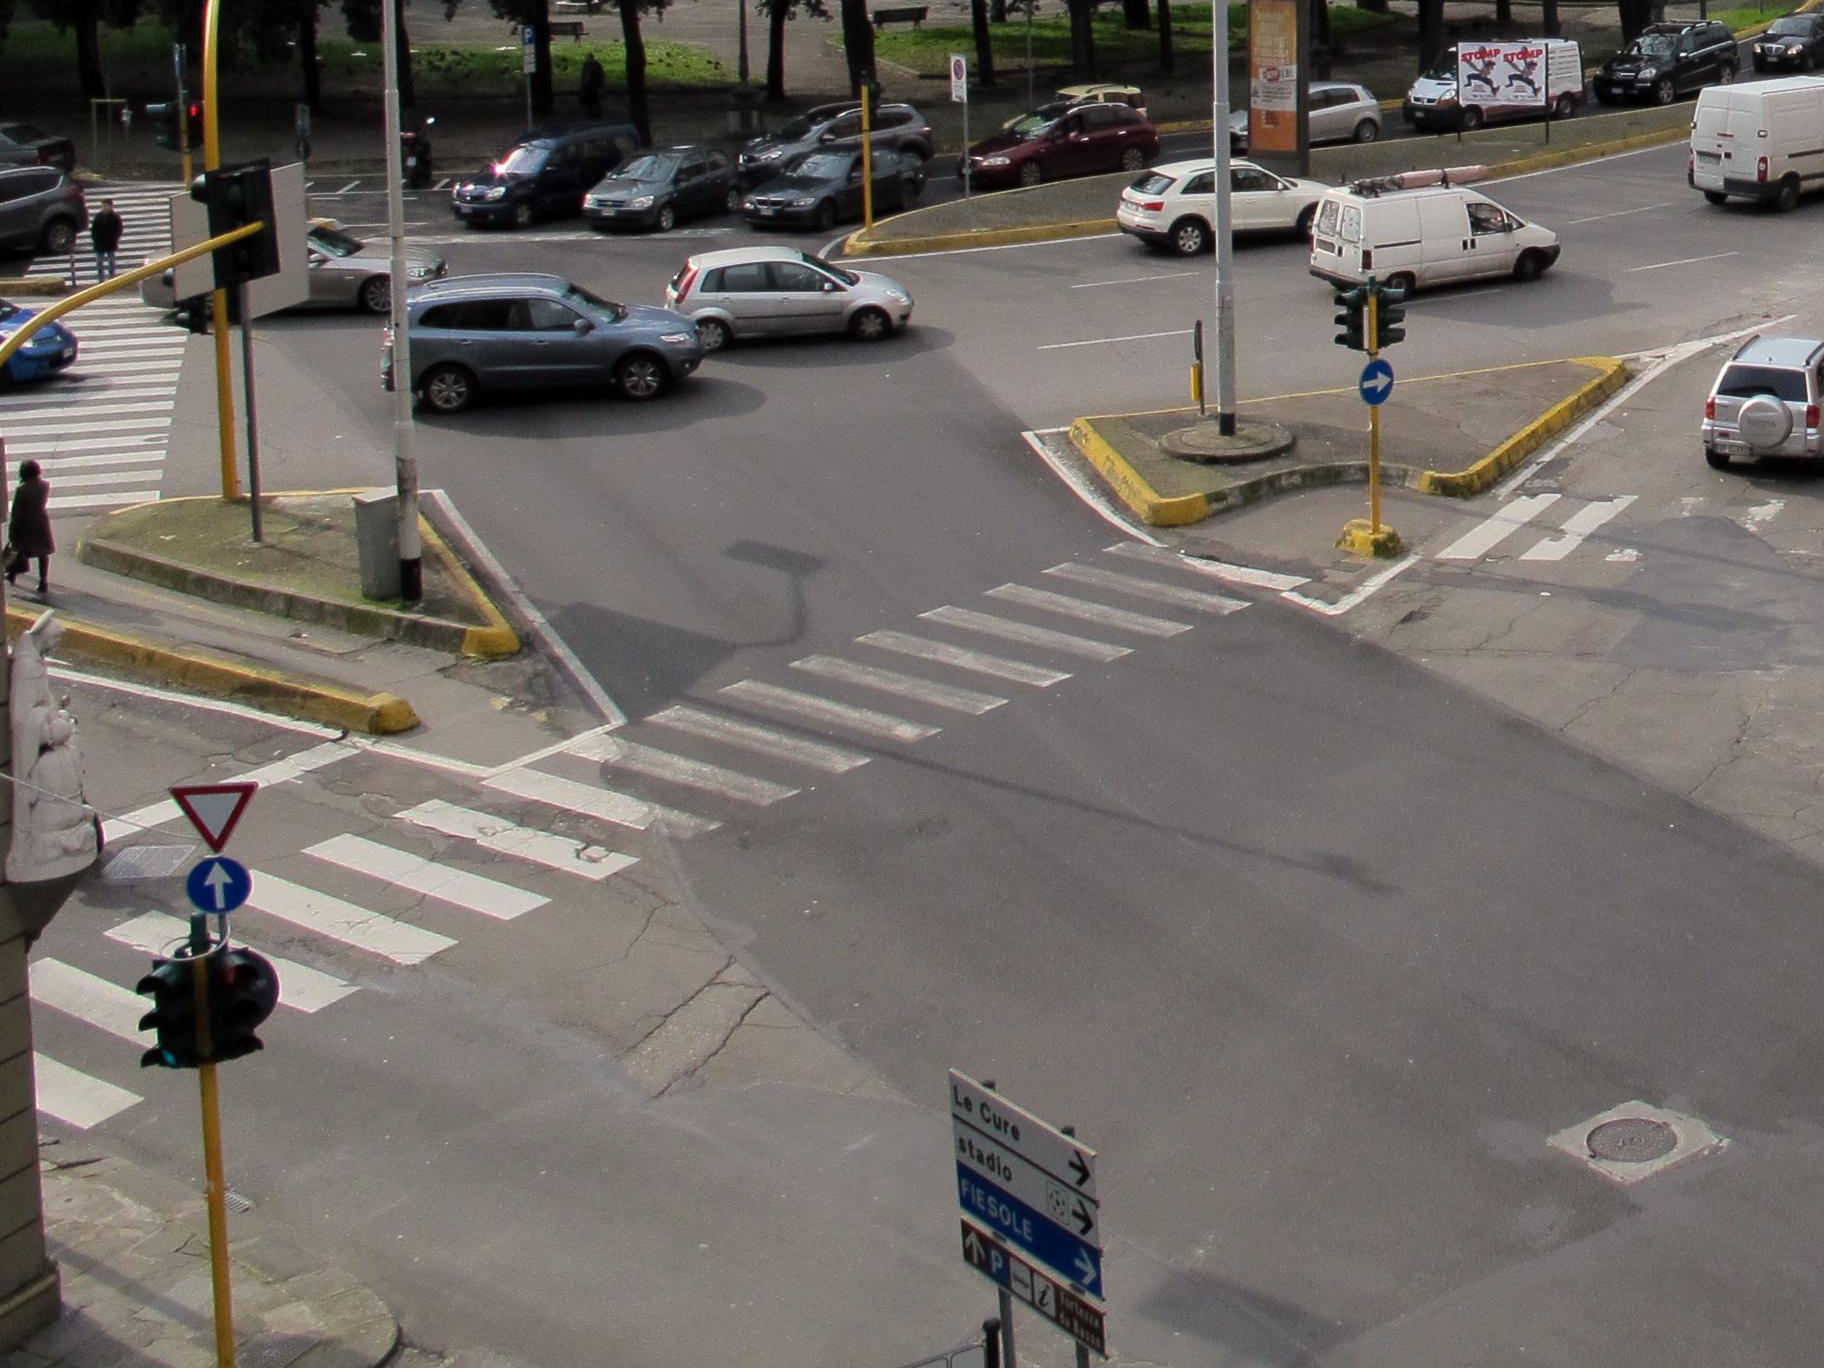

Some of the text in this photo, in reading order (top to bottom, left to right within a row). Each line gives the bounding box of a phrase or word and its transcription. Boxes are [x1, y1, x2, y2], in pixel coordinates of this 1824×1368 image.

[1461, 48, 1501, 62] STOMP
[1503, 48, 1543, 62] STOMP
[953, 1085, 1020, 1142] Le Cure
[958, 1136, 1013, 1182] stadio
[960, 1179, 1033, 1243] FIESOLE
[990, 1249, 1003, 1275] P
